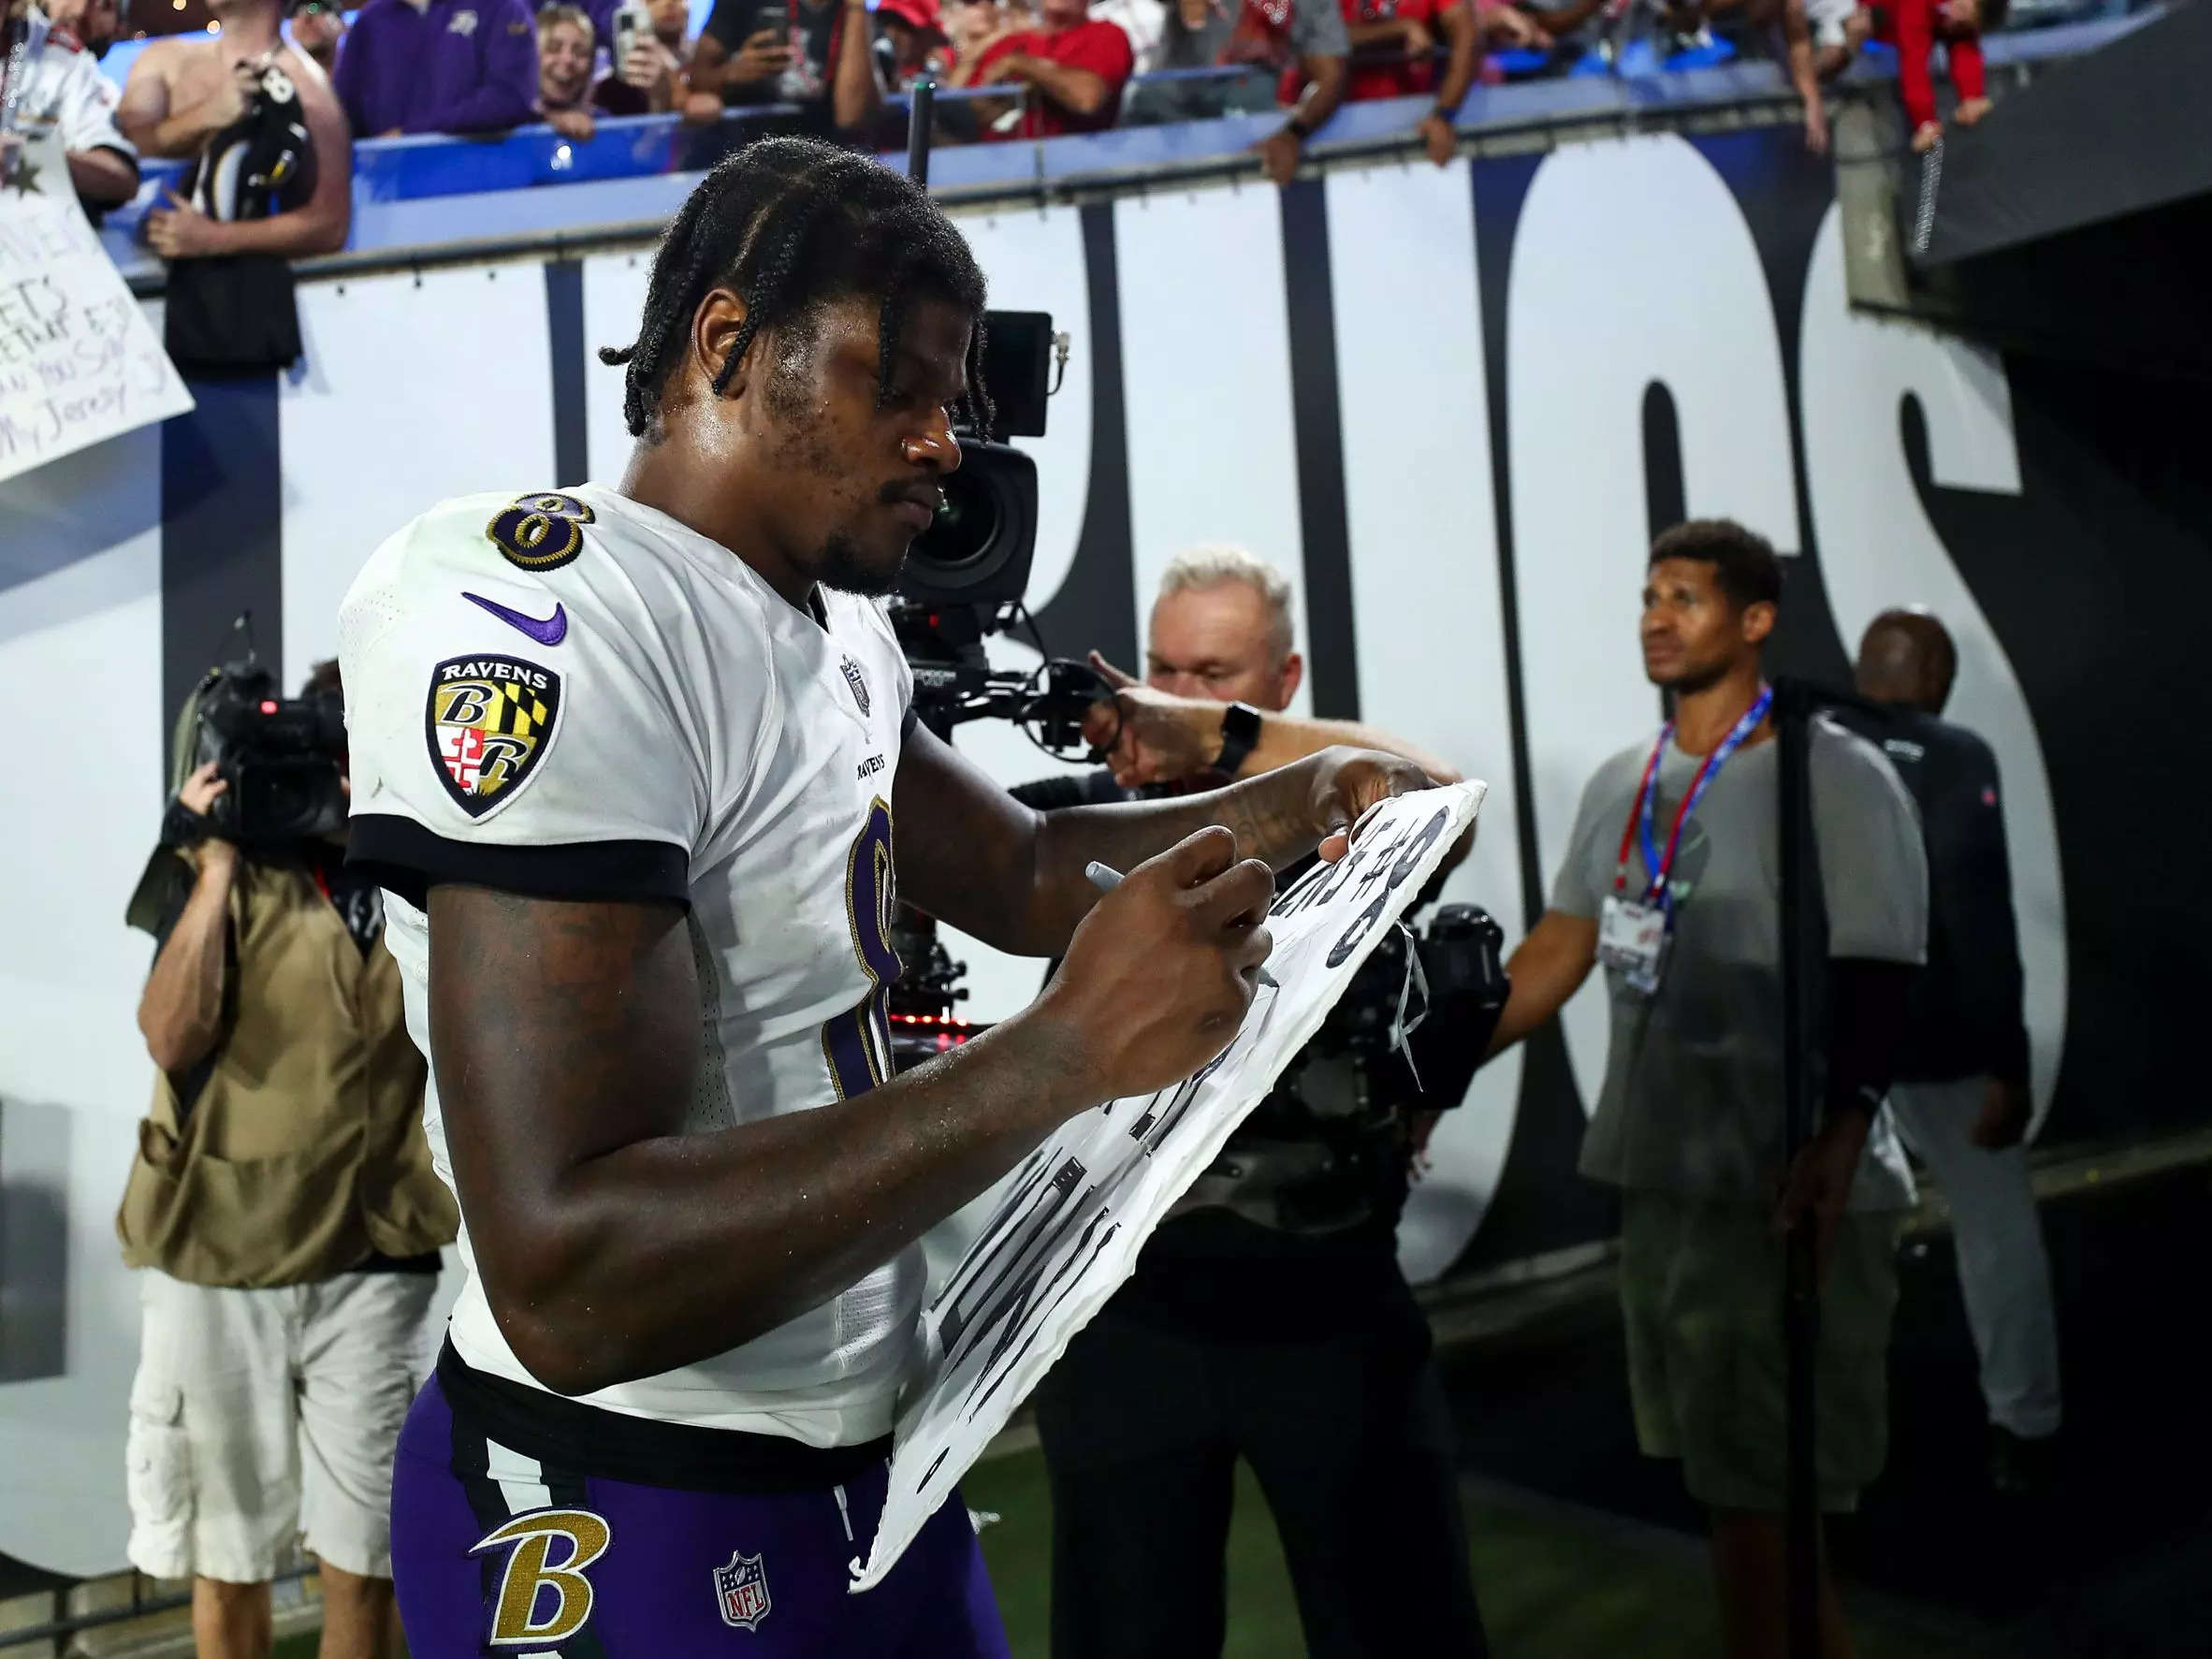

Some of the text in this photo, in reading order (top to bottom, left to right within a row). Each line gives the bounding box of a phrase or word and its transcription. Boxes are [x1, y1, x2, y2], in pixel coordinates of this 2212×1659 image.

[485, 492, 595, 573] 8
[442, 662, 548, 690] RAVENS
[440, 683, 497, 725] B
[857, 753, 885, 780] RAVENS
[469, 1508, 611, 1647] B
[726, 1583, 764, 1618] NFL
